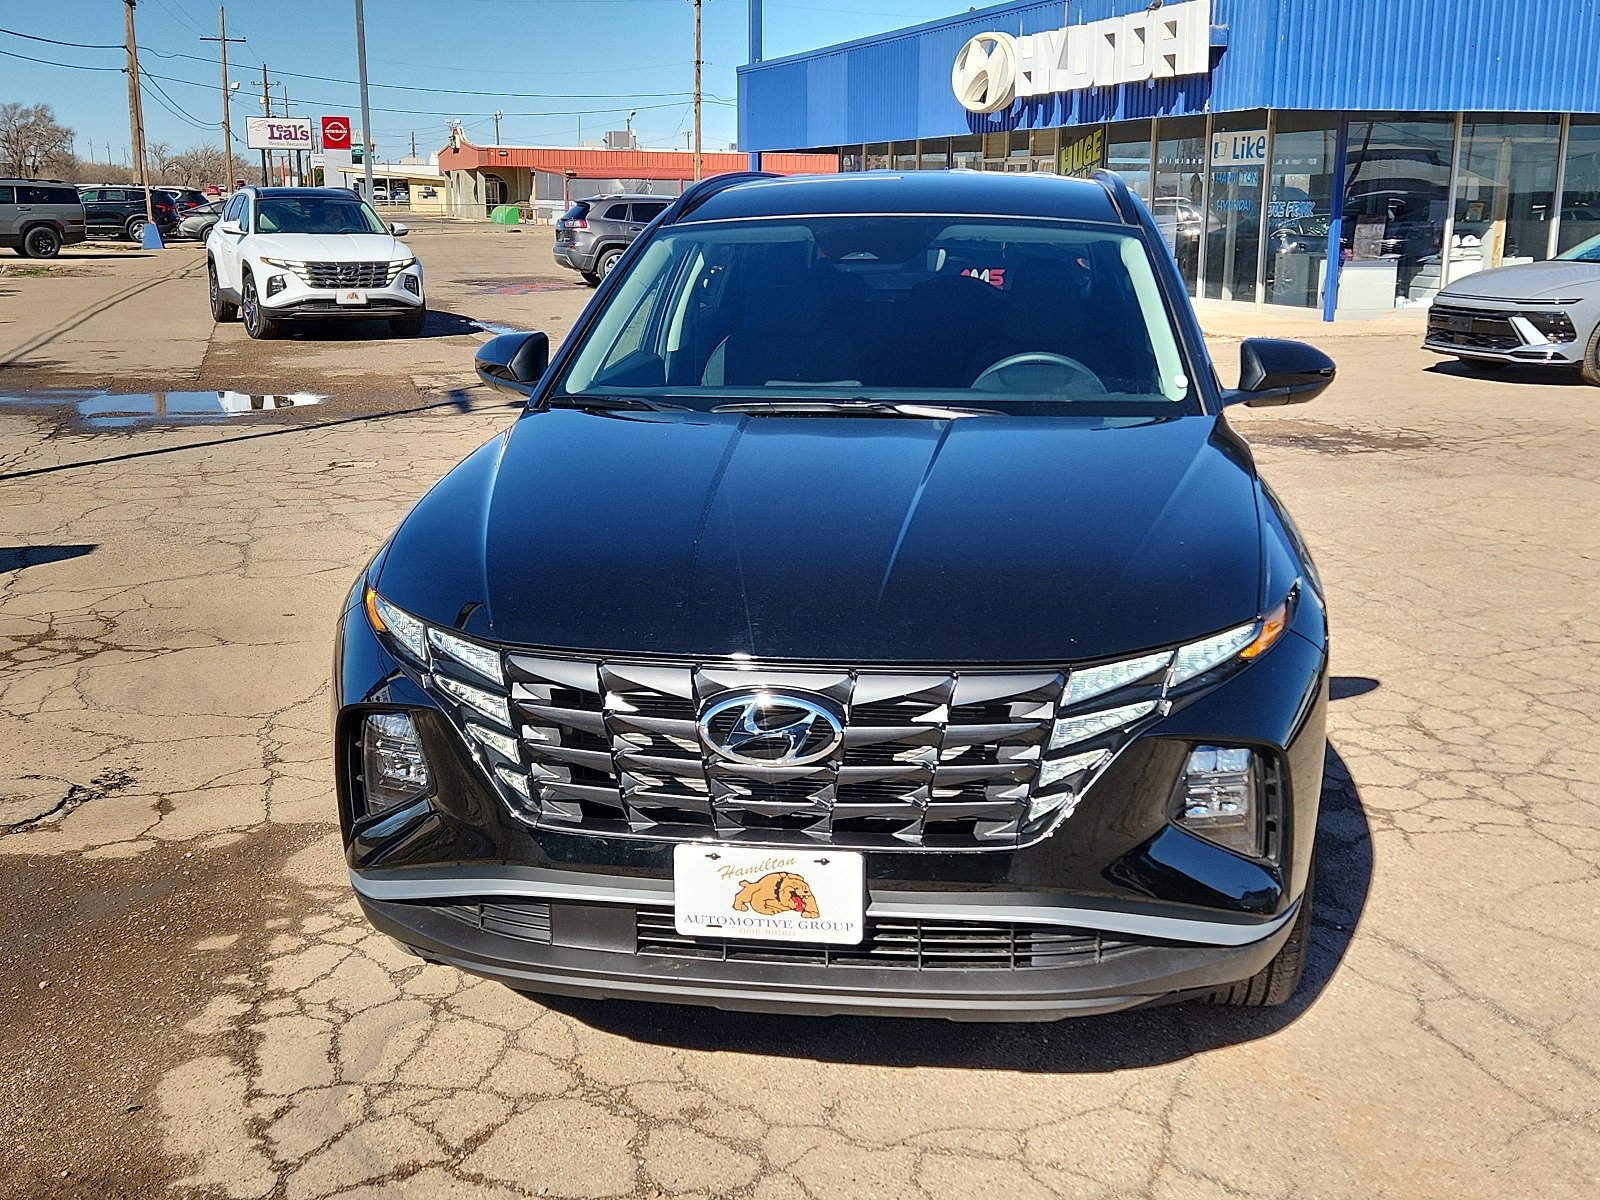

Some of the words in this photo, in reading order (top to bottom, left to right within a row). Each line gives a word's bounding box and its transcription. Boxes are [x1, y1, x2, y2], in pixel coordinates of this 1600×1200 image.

[1015, 0, 1211, 97] HYUNDAI
[268, 124, 309, 141] Leal's
[1061, 129, 1102, 175] HUGE
[1232, 135, 1265, 159] Like
[721, 858, 796, 880] Hamilton
[685, 914, 792, 930] AUTOMOTIVE
[797, 920, 854, 932] GROUP
